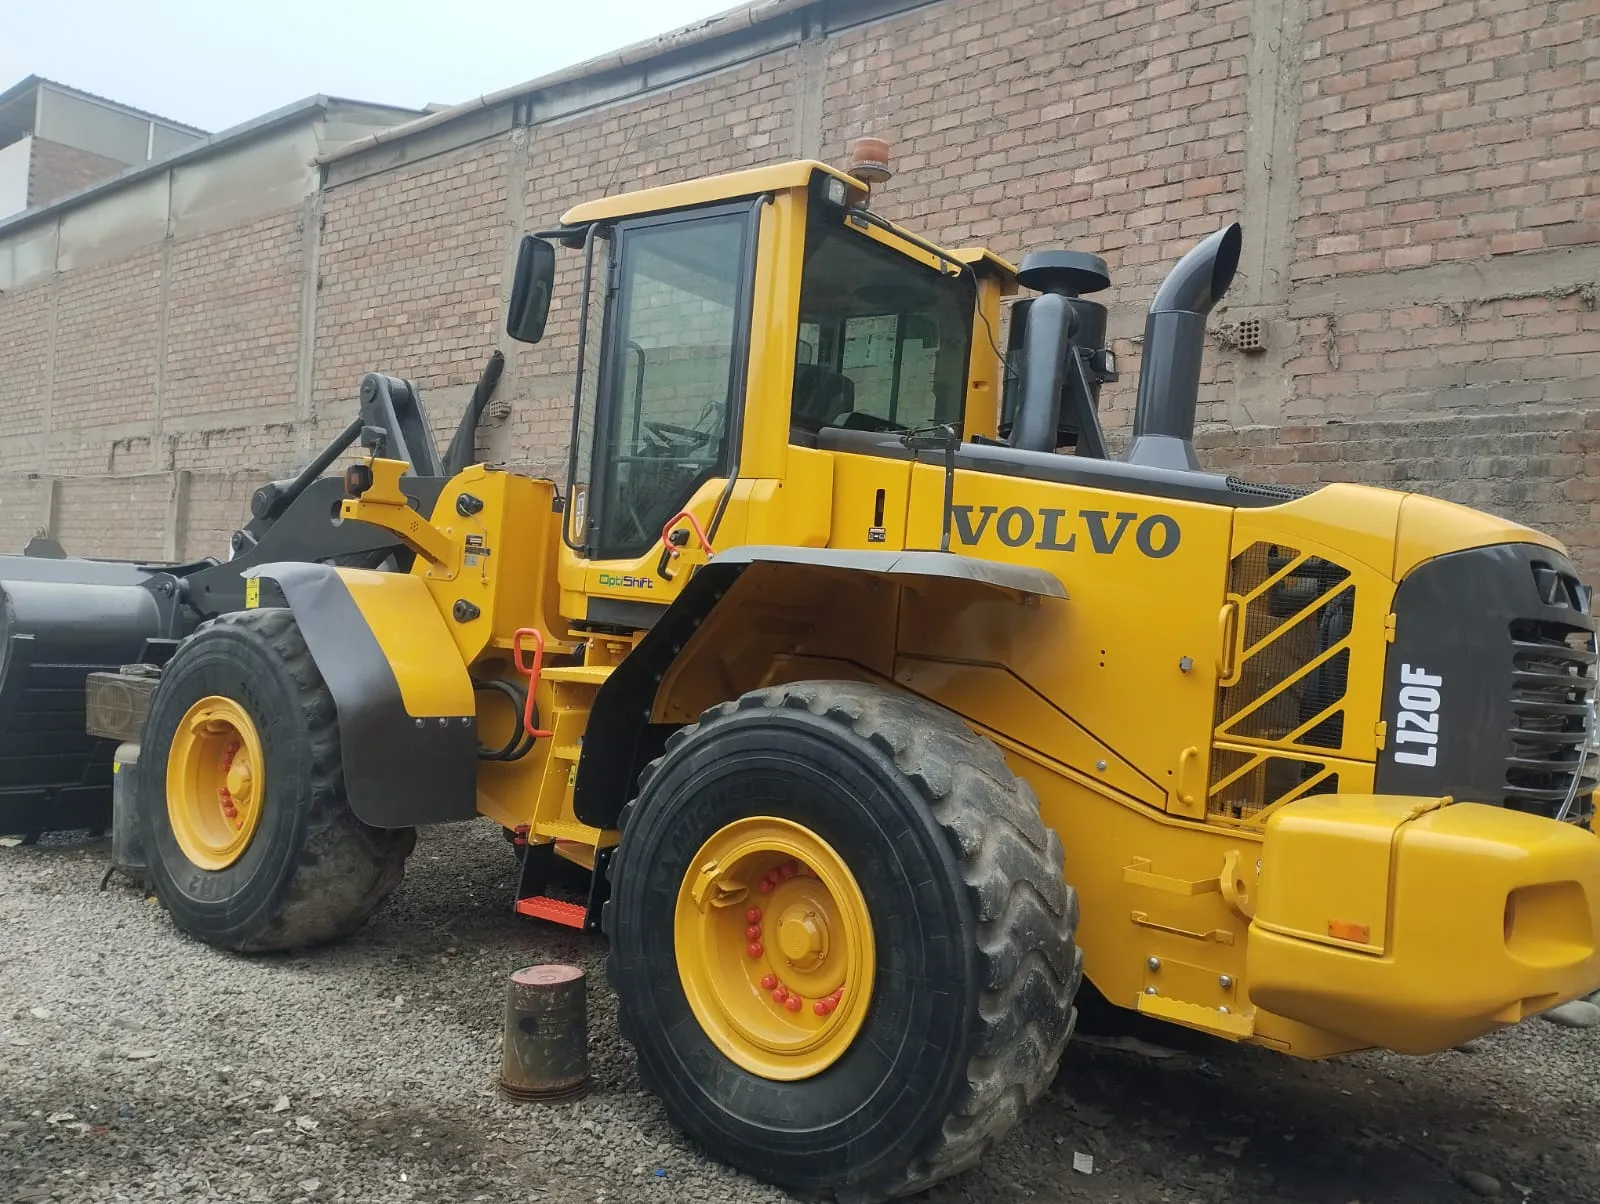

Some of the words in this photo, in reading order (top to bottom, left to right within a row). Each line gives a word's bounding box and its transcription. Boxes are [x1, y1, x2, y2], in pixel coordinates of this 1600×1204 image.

[951, 504, 1182, 559] VOLVO
[599, 574, 654, 588] OptiShift
[1394, 663, 1443, 767] L120F
